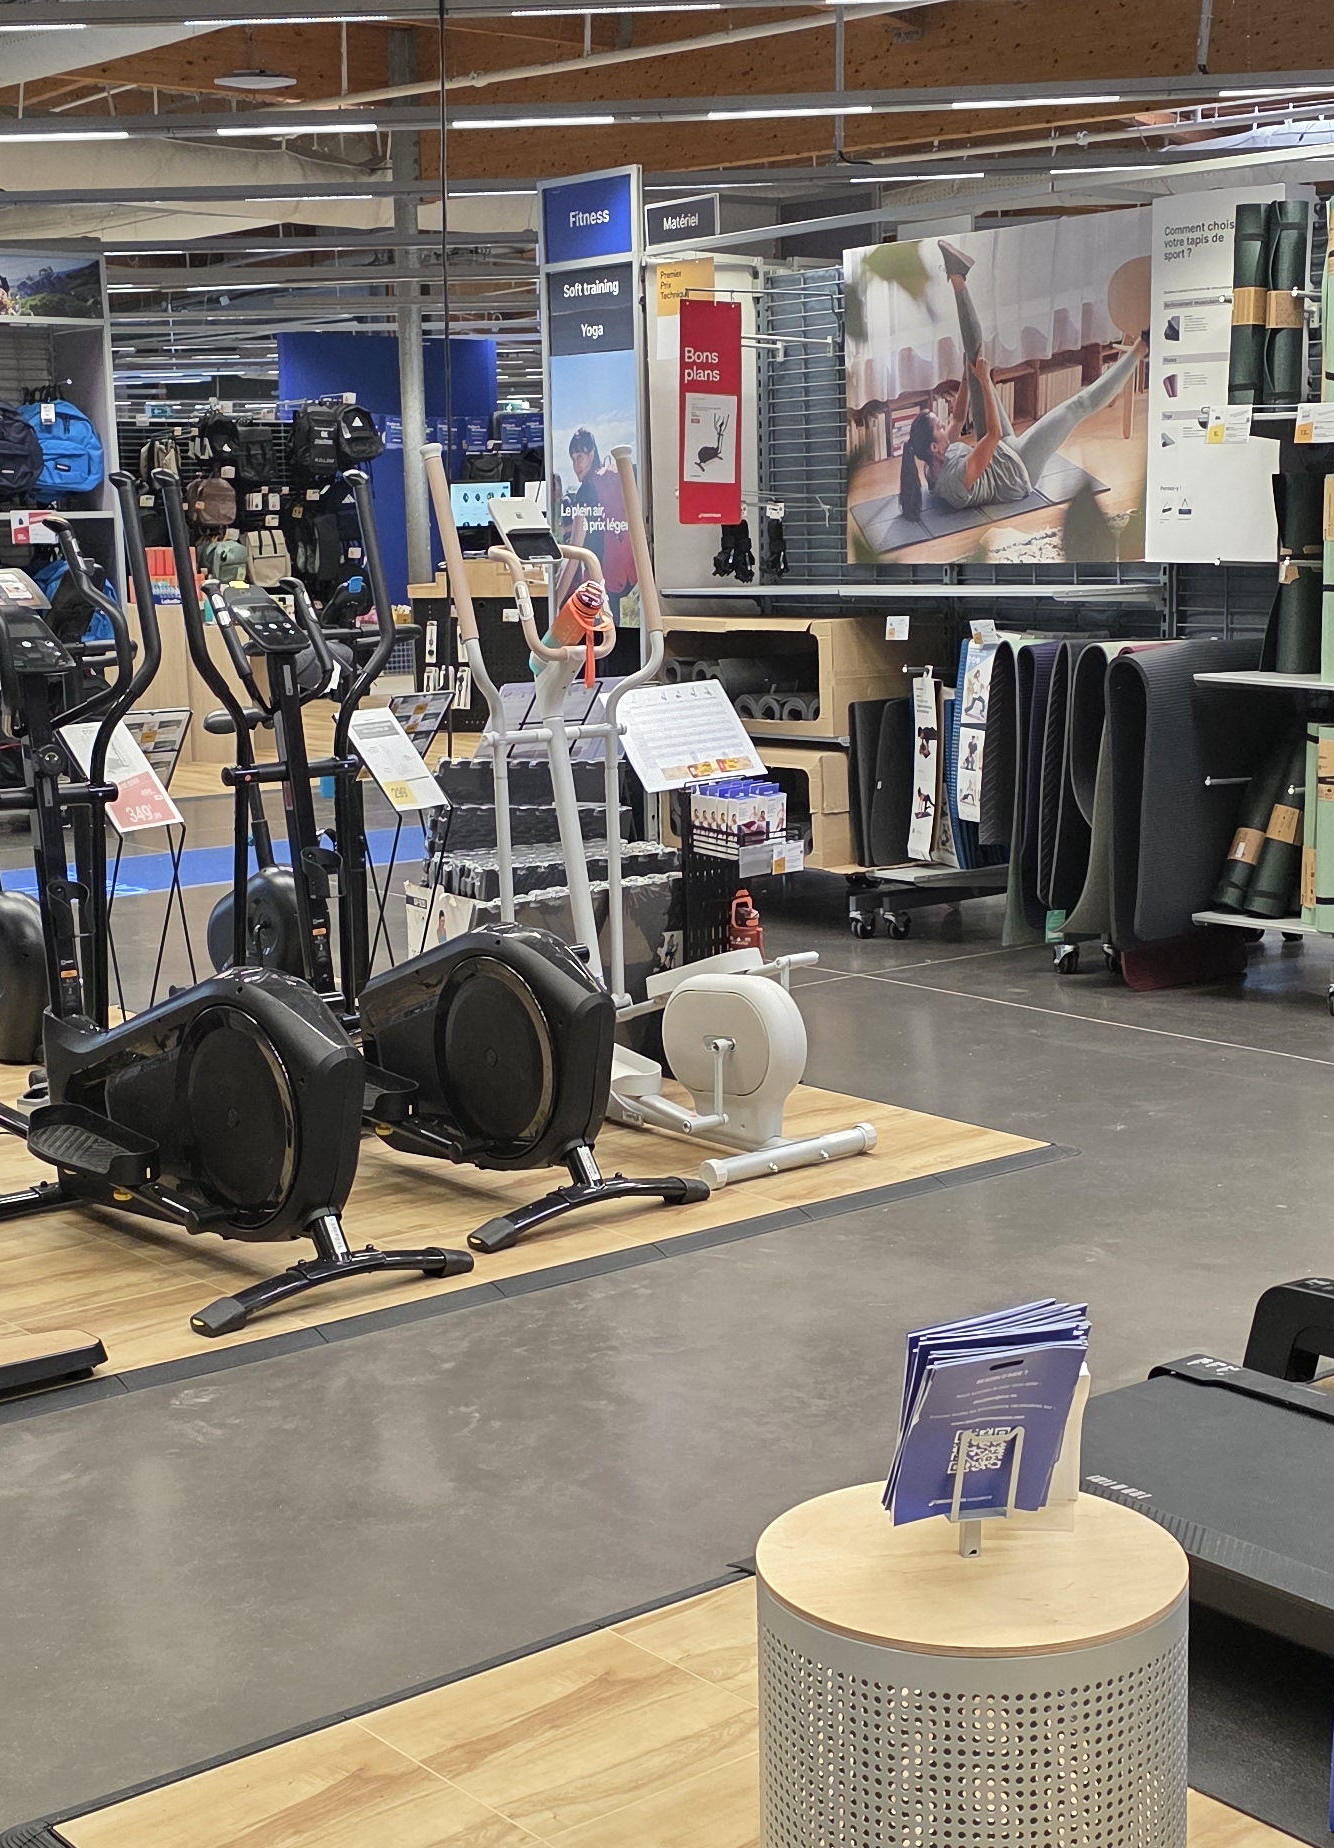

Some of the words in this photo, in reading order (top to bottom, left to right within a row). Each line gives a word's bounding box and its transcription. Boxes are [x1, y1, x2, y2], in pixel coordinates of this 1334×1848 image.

[569, 209, 610, 228] Fitness
[663, 213, 699, 231] Matériel
[1164, 223, 1205, 237] Comment
[1207, 219, 1235, 232] chois
[1164, 238, 1184, 248] votre
[1187, 234, 1209, 247] tapis
[1211, 233, 1224, 243] de
[1164, 250, 1185, 262] sport
[1187, 247, 1192, 258] ?
[660, 270, 682, 280] Premier
[563, 283, 583, 298] Soft
[583, 279, 619, 296] training
[660, 281, 672, 290] Prix
[581, 323, 604, 340] Yoga
[684, 347, 719, 363] Bons
[685, 365, 720, 384] plans
[561, 504, 571, 516] Le
[572, 503, 592, 519] plein
[593, 503, 605, 519] air,
[590, 518, 605, 534] prix
